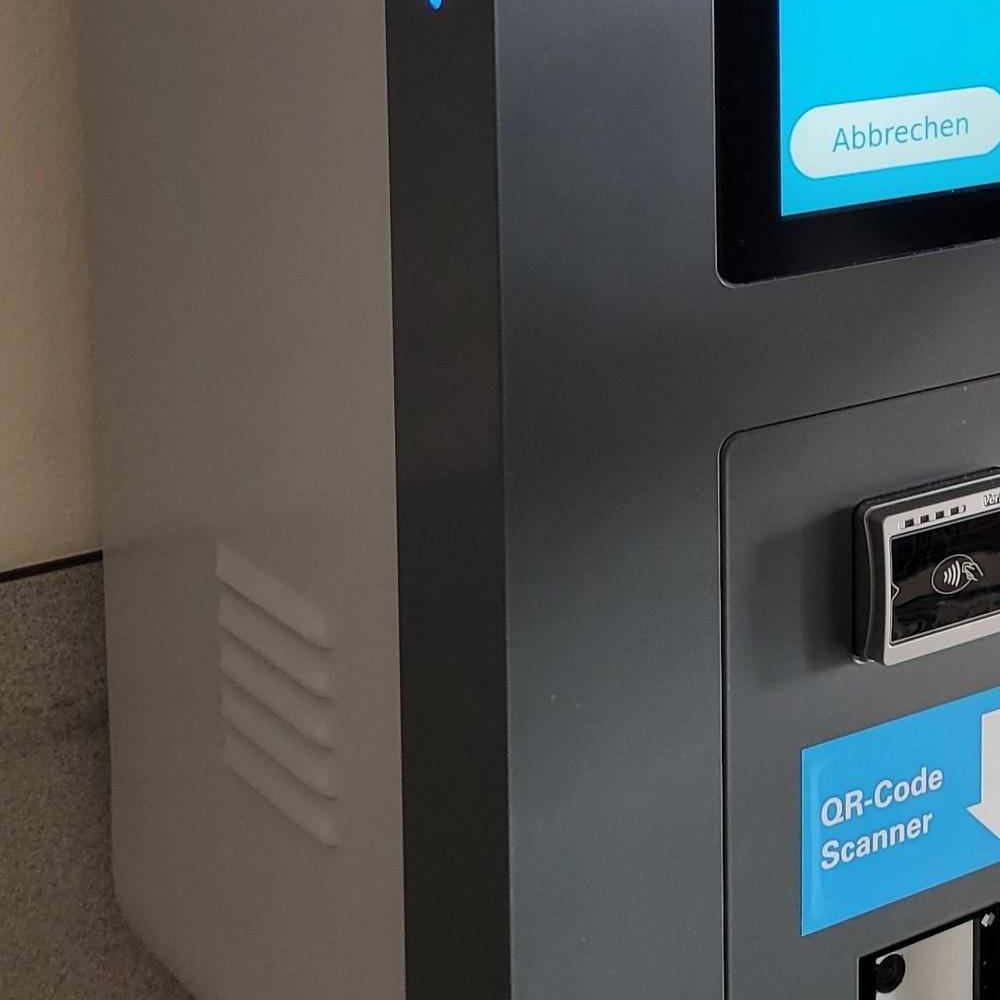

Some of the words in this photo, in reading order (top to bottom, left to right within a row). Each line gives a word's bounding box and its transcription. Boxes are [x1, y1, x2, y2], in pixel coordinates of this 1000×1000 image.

[832, 116, 969, 153] Abbrechen
[820, 766, 944, 826] QR-Code
[820, 812, 933, 870] Scanner
